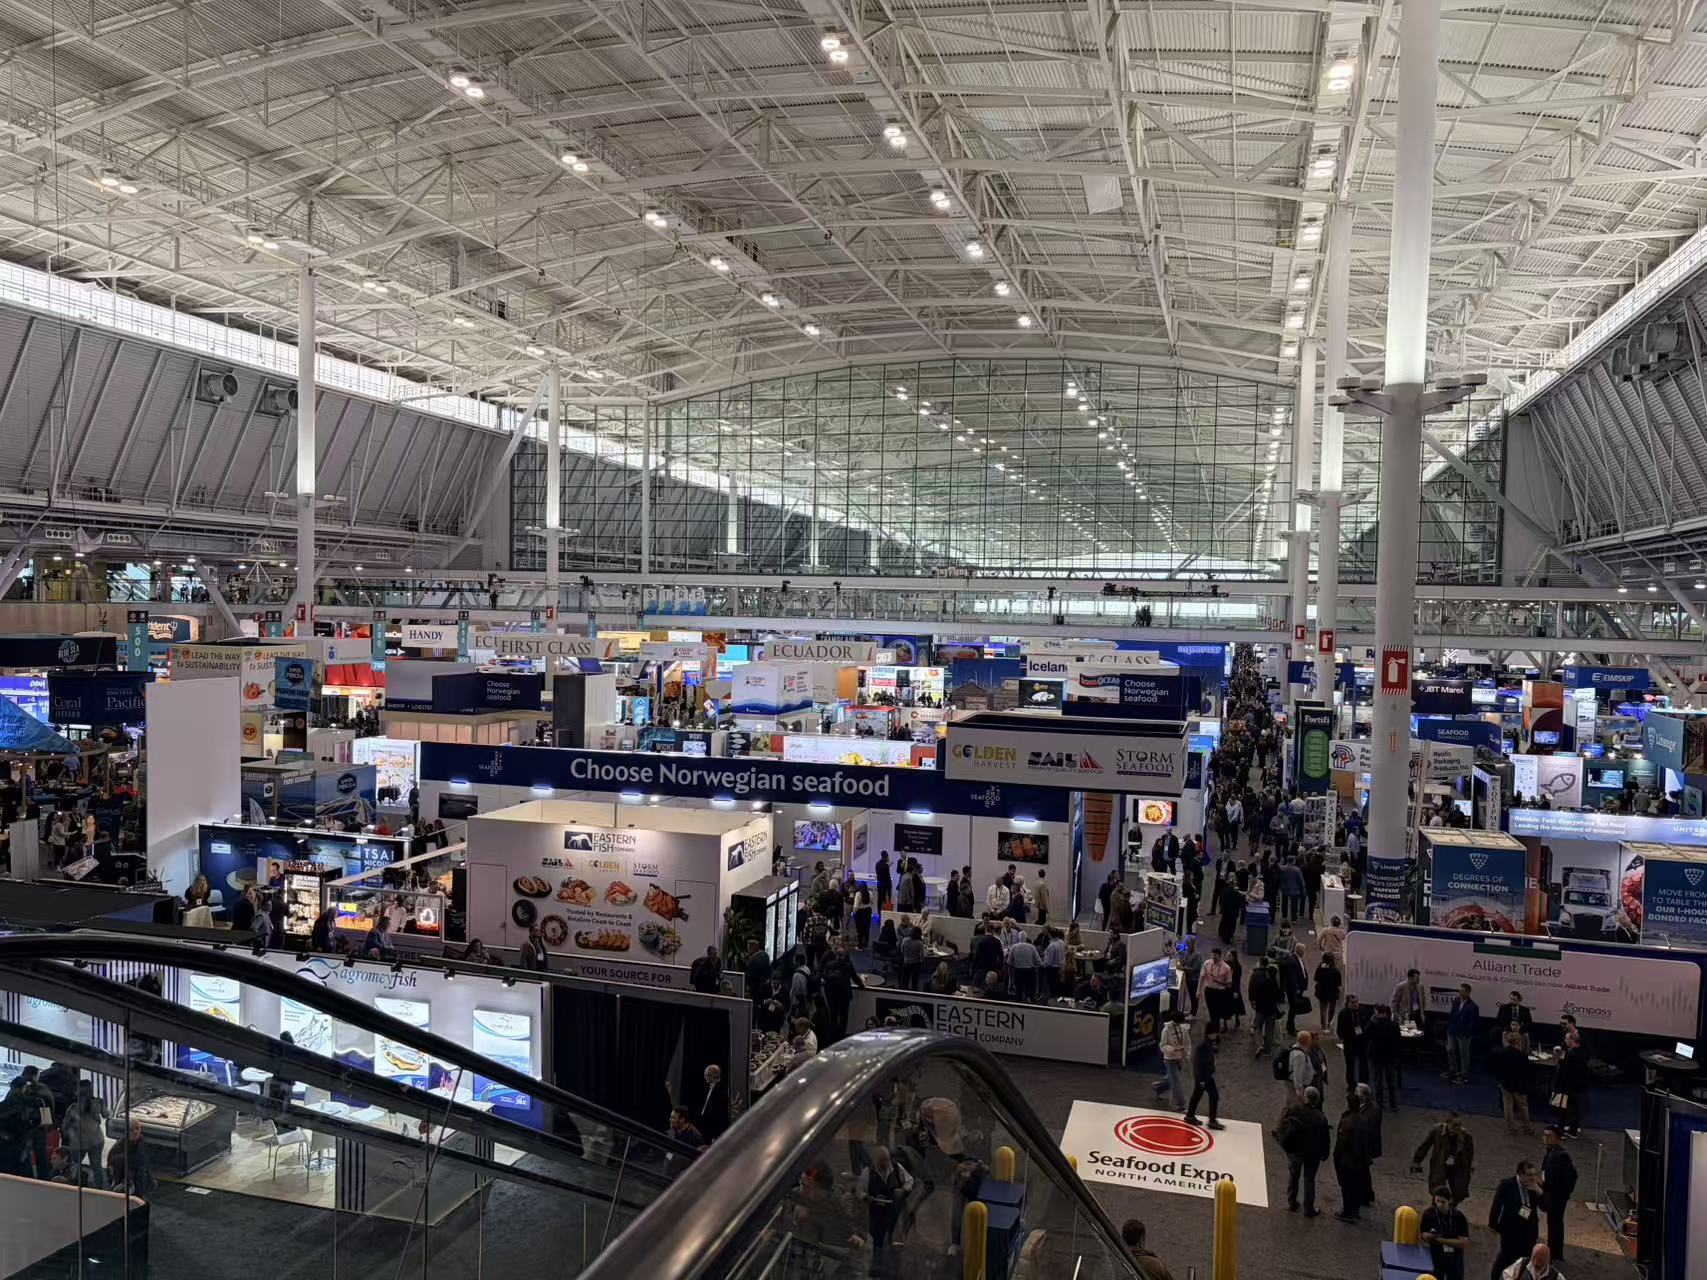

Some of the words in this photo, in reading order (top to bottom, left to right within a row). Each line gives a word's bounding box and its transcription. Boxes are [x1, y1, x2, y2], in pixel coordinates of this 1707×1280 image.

[409, 629, 444, 641] HANDY
[501, 641, 542, 654] FIRST
[547, 642, 592, 656] CLASS
[772, 644, 853, 659] ECUADOR
[191, 651, 209, 660] LEAD
[210, 652, 223, 660] THE
[225, 653, 241, 661] WAY
[185, 661, 241, 671] SUSTAINABILITY
[1603, 674, 1635, 683] EIMSKIP
[487, 680, 511, 689] Choose
[1124, 680, 1156, 689] Choose
[1424, 685, 1440, 694] JBT
[1441, 686, 1465, 695] Marel
[487, 688, 521, 696] Norwegian
[1124, 687, 1169, 697] Norwegian
[54, 696, 81, 708] Coral
[487, 694, 512, 702] seafood
[1124, 693, 1158, 703] seafood
[1304, 714, 1331, 724] Fortifi
[1437, 729, 1470, 737] SEAFOOD
[952, 745, 1017, 761] GOLDEN
[1117, 748, 1173, 763] STORM
[974, 760, 1016, 769] HARVEST
[1116, 761, 1174, 773] SEAFOOD
[1434, 758, 1461, 766] Packaging
[570, 758, 654, 784] Choose
[659, 763, 786, 794] Norwegian
[791, 771, 890, 797] seafood
[970, 794, 1001, 802] SEAFOOD
[1673, 825, 1705, 833] UNITED
[593, 832, 636, 845] EASTERN
[593, 842, 614, 853] FISH
[363, 846, 396, 861] TSA
[632, 862, 658, 870] STORM
[1452, 872, 1490, 883] DEGREES
[1491, 875, 1504, 883] OF
[1447, 881, 1509, 893] CONNECTION
[1658, 888, 1683, 897] MOVE
[1376, 892, 1401, 900] DEGREES
[1652, 896, 1663, 904] TO
[1666, 898, 1691, 907] TABLE
[566, 907, 587, 916] Trusted
[587, 910, 594, 918] by
[595, 911, 627, 920] Restaurants
[1656, 905, 1675, 914] OUR
[1647, 913, 1687, 923] BONDED
[1472, 959, 1518, 975] Alliant
[1521, 963, 1562, 978] Trade
[339, 966, 417, 990] agromeyfish
[581, 965, 607, 977] YOUR
[610, 968, 649, 982] SOURCE
[651, 972, 672, 984] FOR
[1500, 977, 1534, 988] Compass
[1547, 982, 1563, 990] now
[1564, 982, 1588, 991] Alliant
[1589, 985, 1610, 994] Trade
[1564, 1001, 1613, 1016] Compass
[936, 1003, 1024, 1031] EASTERN
[979, 1033, 1023, 1047] COMPANY
[1087, 1150, 1176, 1176] Seafood
[1180, 1163, 1234, 1184] Expo
[1095, 1168, 1147, 1182] NORTH
[1153, 1176, 1213, 1192] AMERIC
